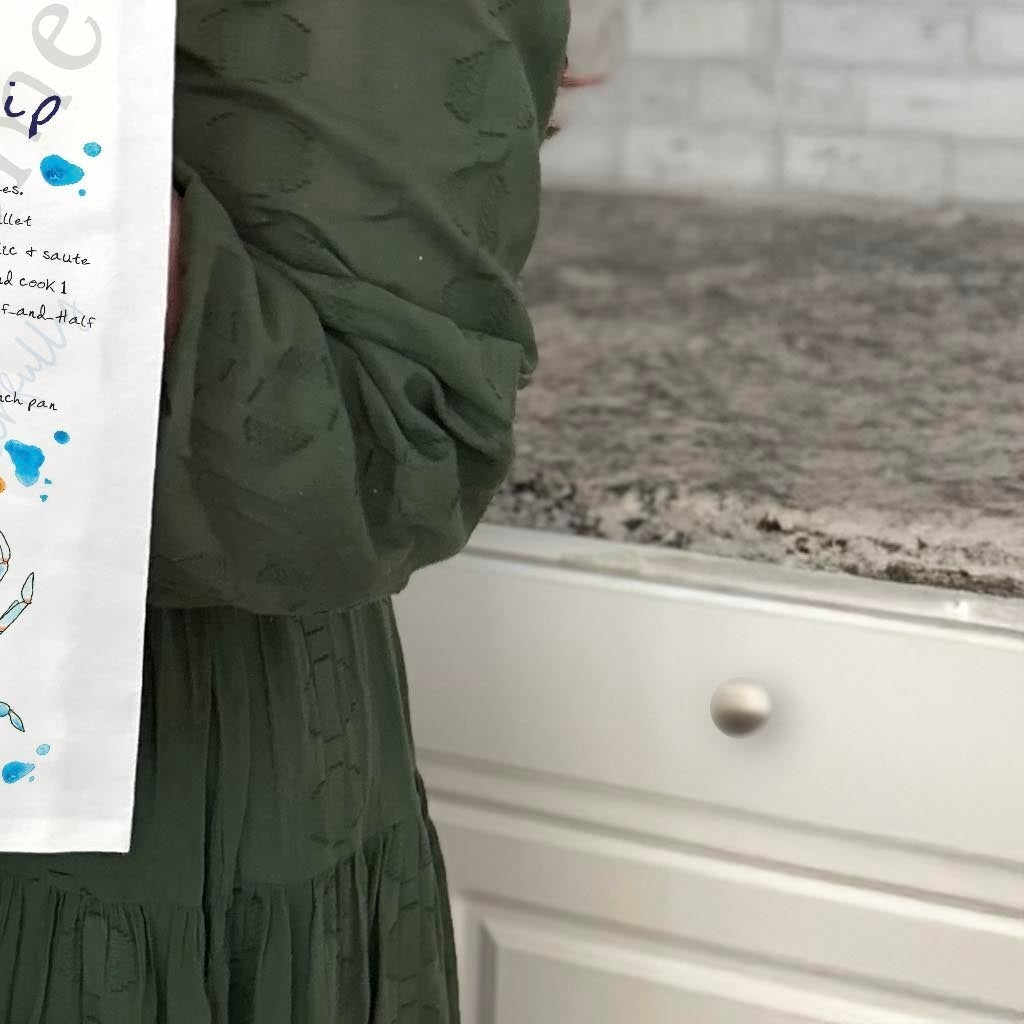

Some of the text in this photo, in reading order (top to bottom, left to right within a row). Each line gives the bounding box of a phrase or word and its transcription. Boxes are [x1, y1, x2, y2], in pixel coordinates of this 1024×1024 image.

[42, 250, 91, 266] saute
[19, 277, 56, 293] cook
[60, 280, 67, 295] 1
[27, 398, 58, 412] pan
